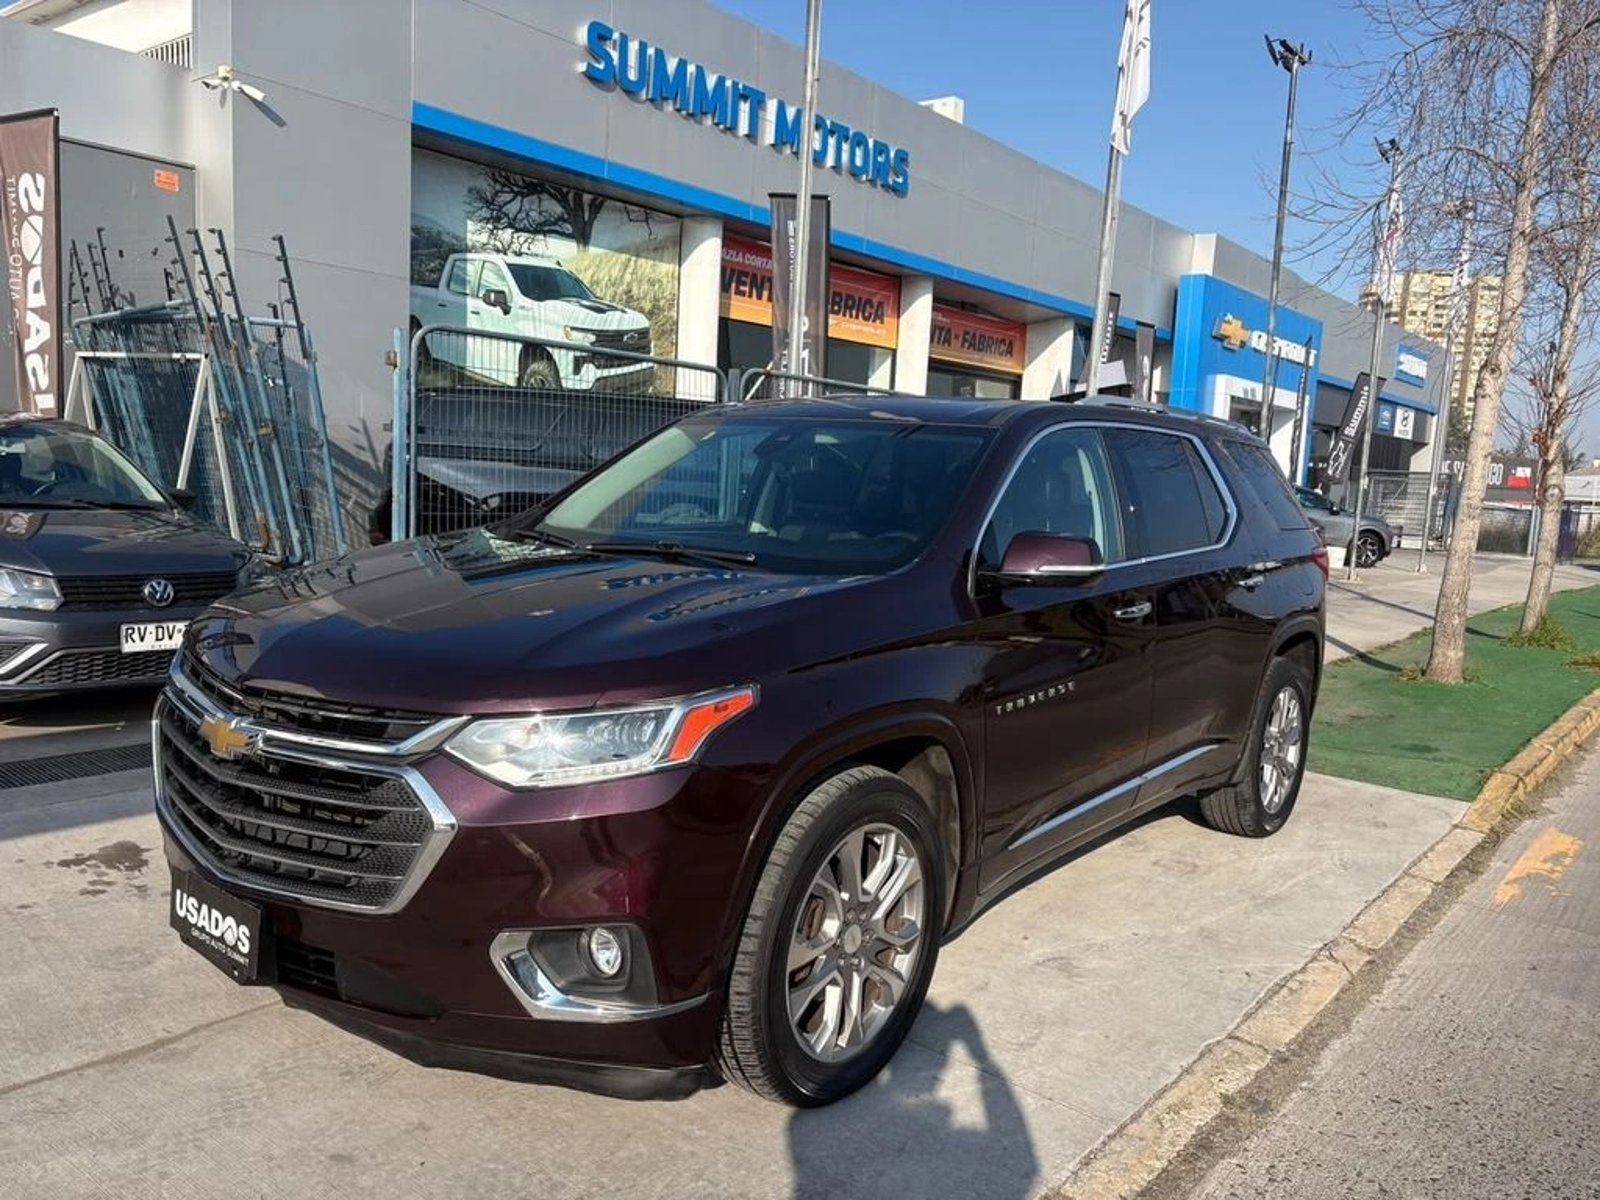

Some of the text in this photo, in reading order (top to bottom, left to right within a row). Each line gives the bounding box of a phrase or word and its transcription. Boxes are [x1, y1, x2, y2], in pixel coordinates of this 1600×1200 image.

[581, 20, 767, 146] SUMMIT
[720, 264, 885, 325] VENT BRICA
[930, 323, 952, 348] NTA
[960, 329, 1014, 359] FABRICA
[175, 888, 250, 954] USADOS
